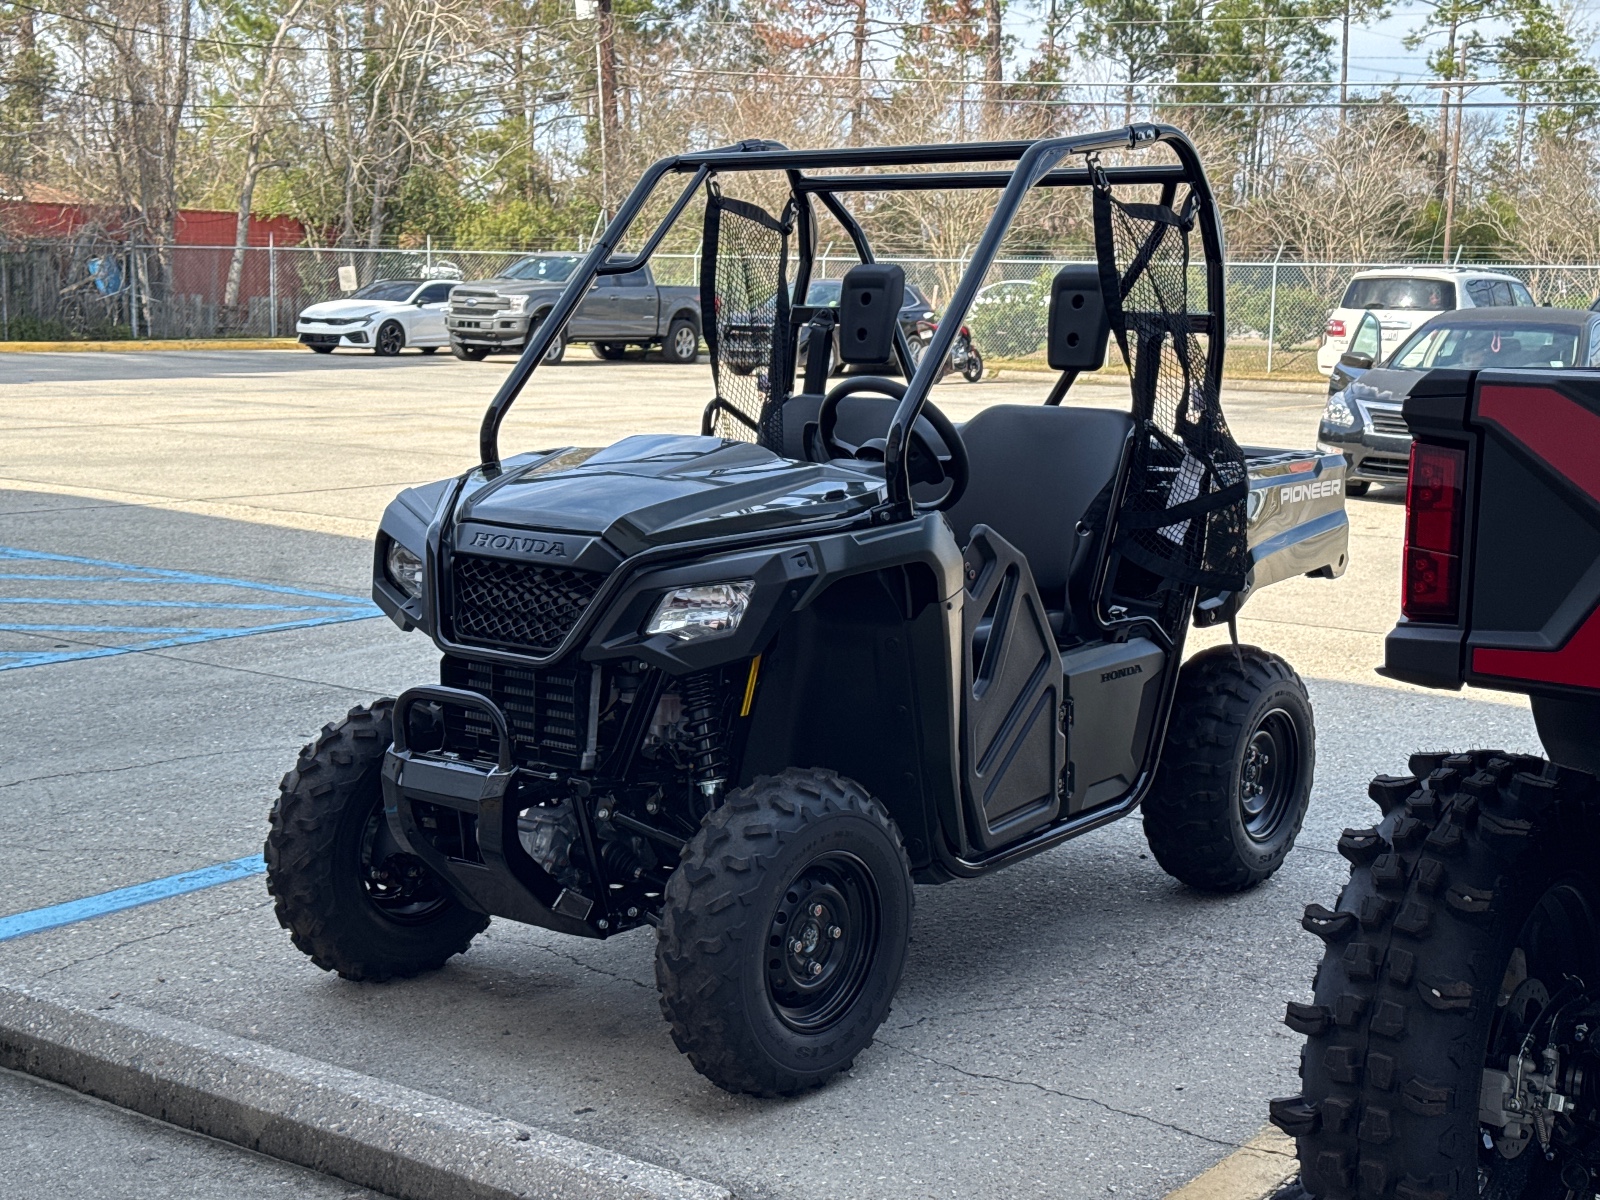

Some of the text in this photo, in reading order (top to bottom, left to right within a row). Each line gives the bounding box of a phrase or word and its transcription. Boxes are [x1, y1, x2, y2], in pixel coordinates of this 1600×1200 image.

[1280, 478, 1341, 505] PIONEER
[469, 532, 568, 558] HONDA
[1100, 664, 1143, 683] HONDA
